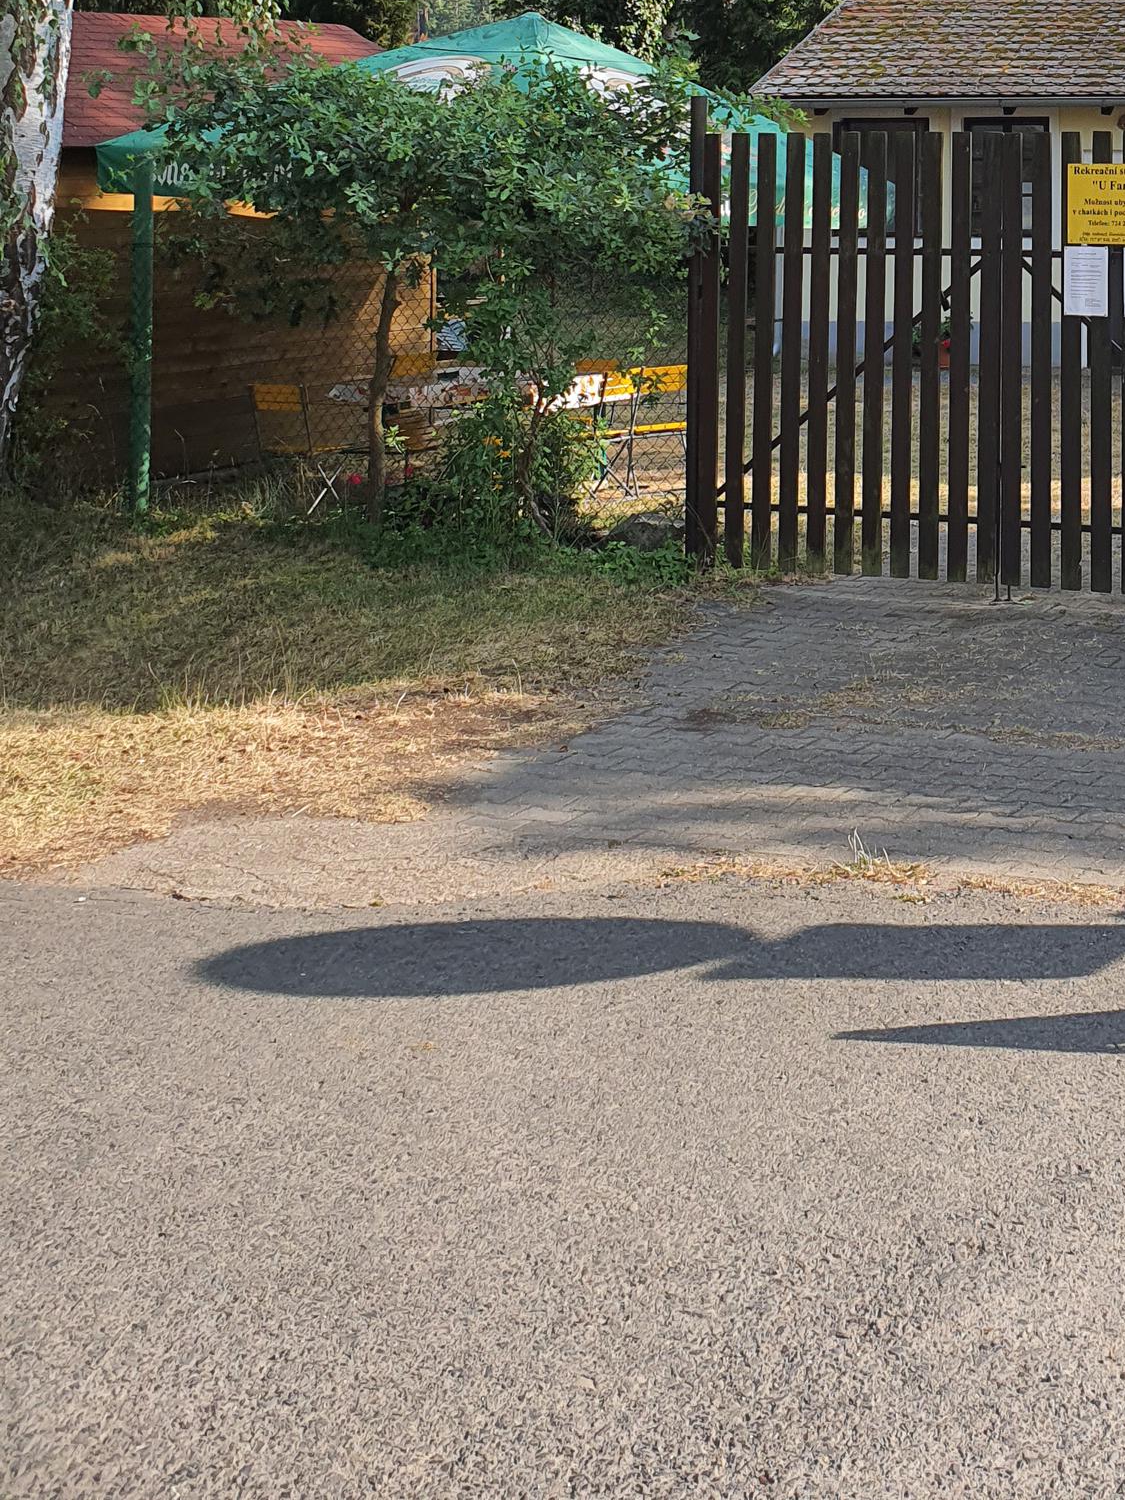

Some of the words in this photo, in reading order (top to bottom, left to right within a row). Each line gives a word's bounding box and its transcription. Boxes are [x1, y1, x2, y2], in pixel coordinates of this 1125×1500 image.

[1073, 166, 1117, 176] Rekreační
[1092, 180, 1107, 191] "U
[1083, 198, 1113, 206] Možnost
[1078, 208, 1109, 216] chatkách
